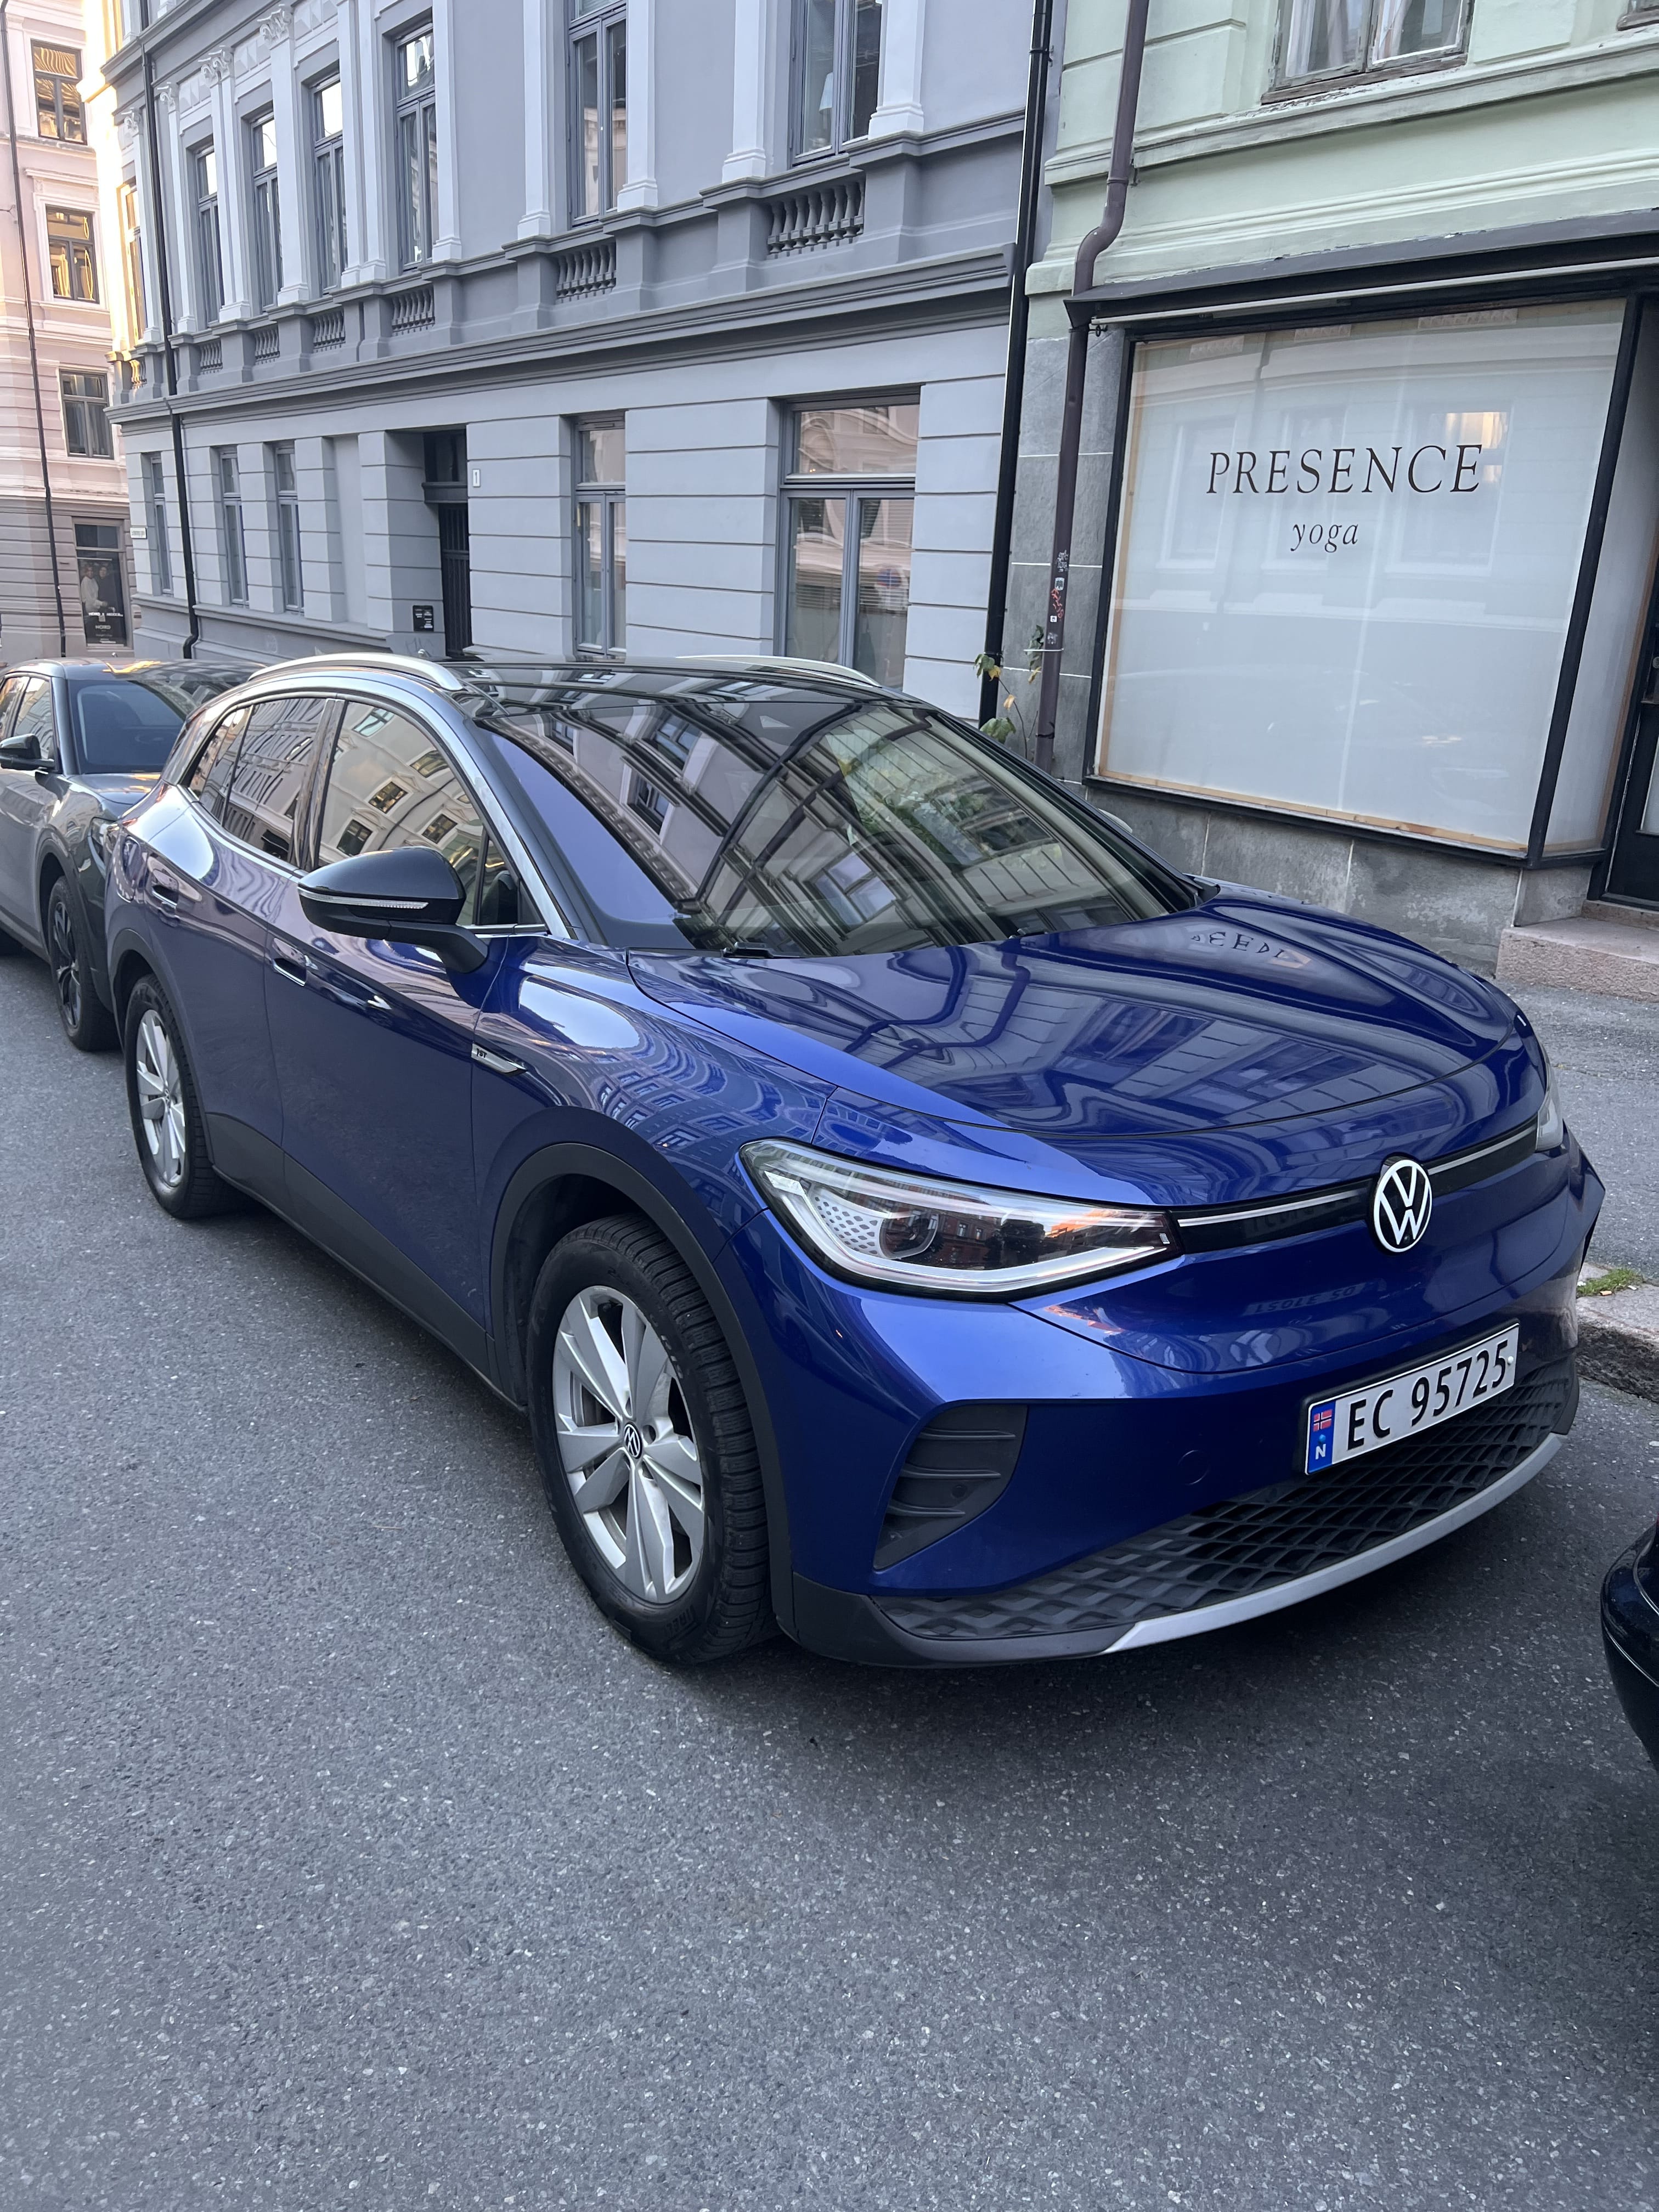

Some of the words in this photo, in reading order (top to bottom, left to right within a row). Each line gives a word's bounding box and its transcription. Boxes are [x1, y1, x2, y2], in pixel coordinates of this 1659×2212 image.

[1206, 444, 1482, 494] PRESENCE
[1290, 522, 1359, 553] yoga
[1377, 1163, 1431, 1249] VW
[1347, 1389, 1393, 1451] EC
[1411, 1340, 1508, 1427] 95725
[1315, 1443, 1327, 1460] N
